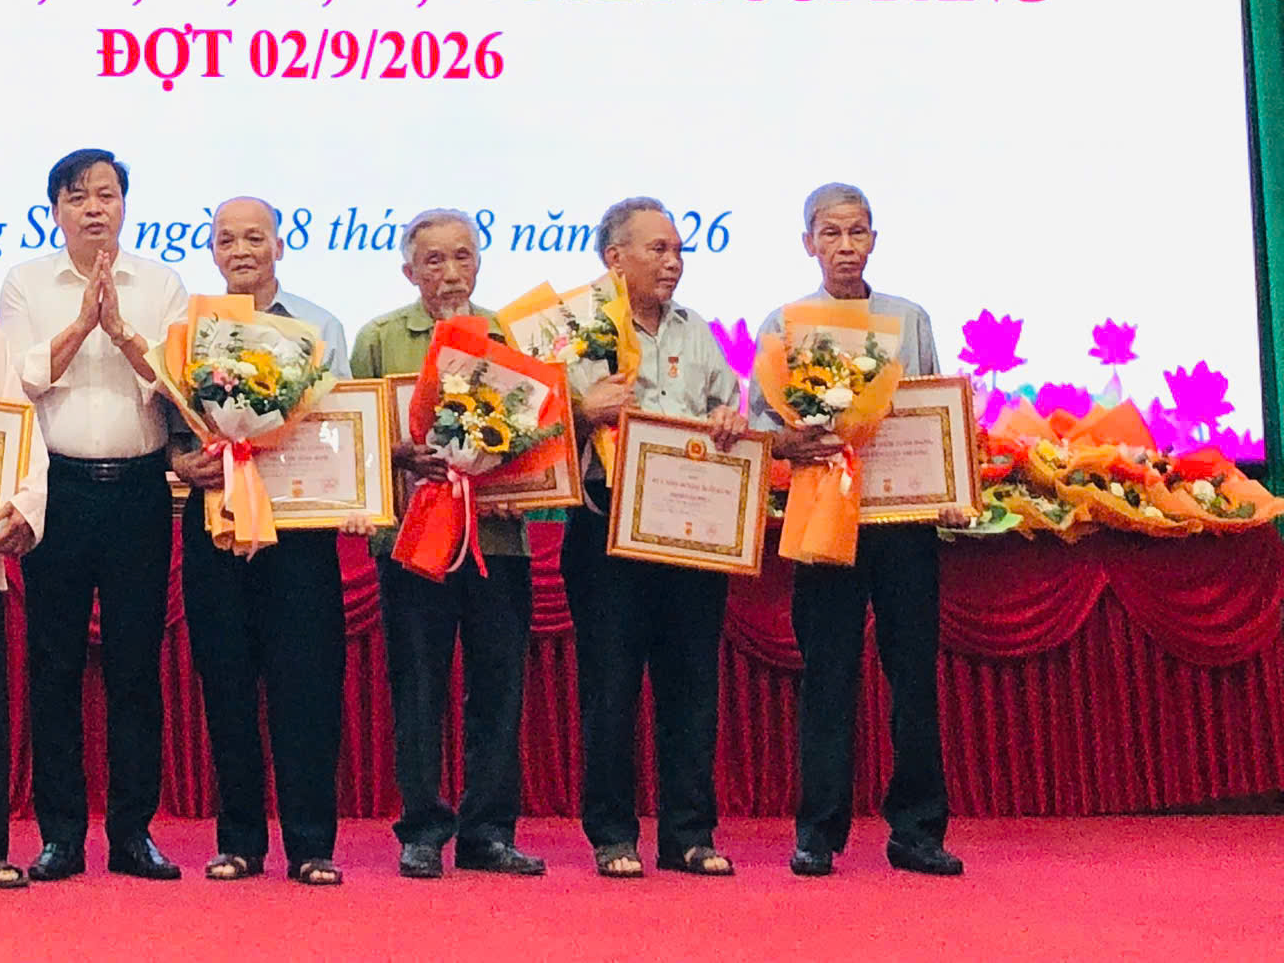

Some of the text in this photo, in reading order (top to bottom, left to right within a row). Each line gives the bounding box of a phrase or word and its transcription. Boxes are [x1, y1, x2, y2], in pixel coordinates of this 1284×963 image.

[96, 23, 505, 92] ĐỢT 02/9/2026
[134, 207, 213, 263] ngà
[328, 207, 408, 251] thá
[475, 208, 495, 252] 8
